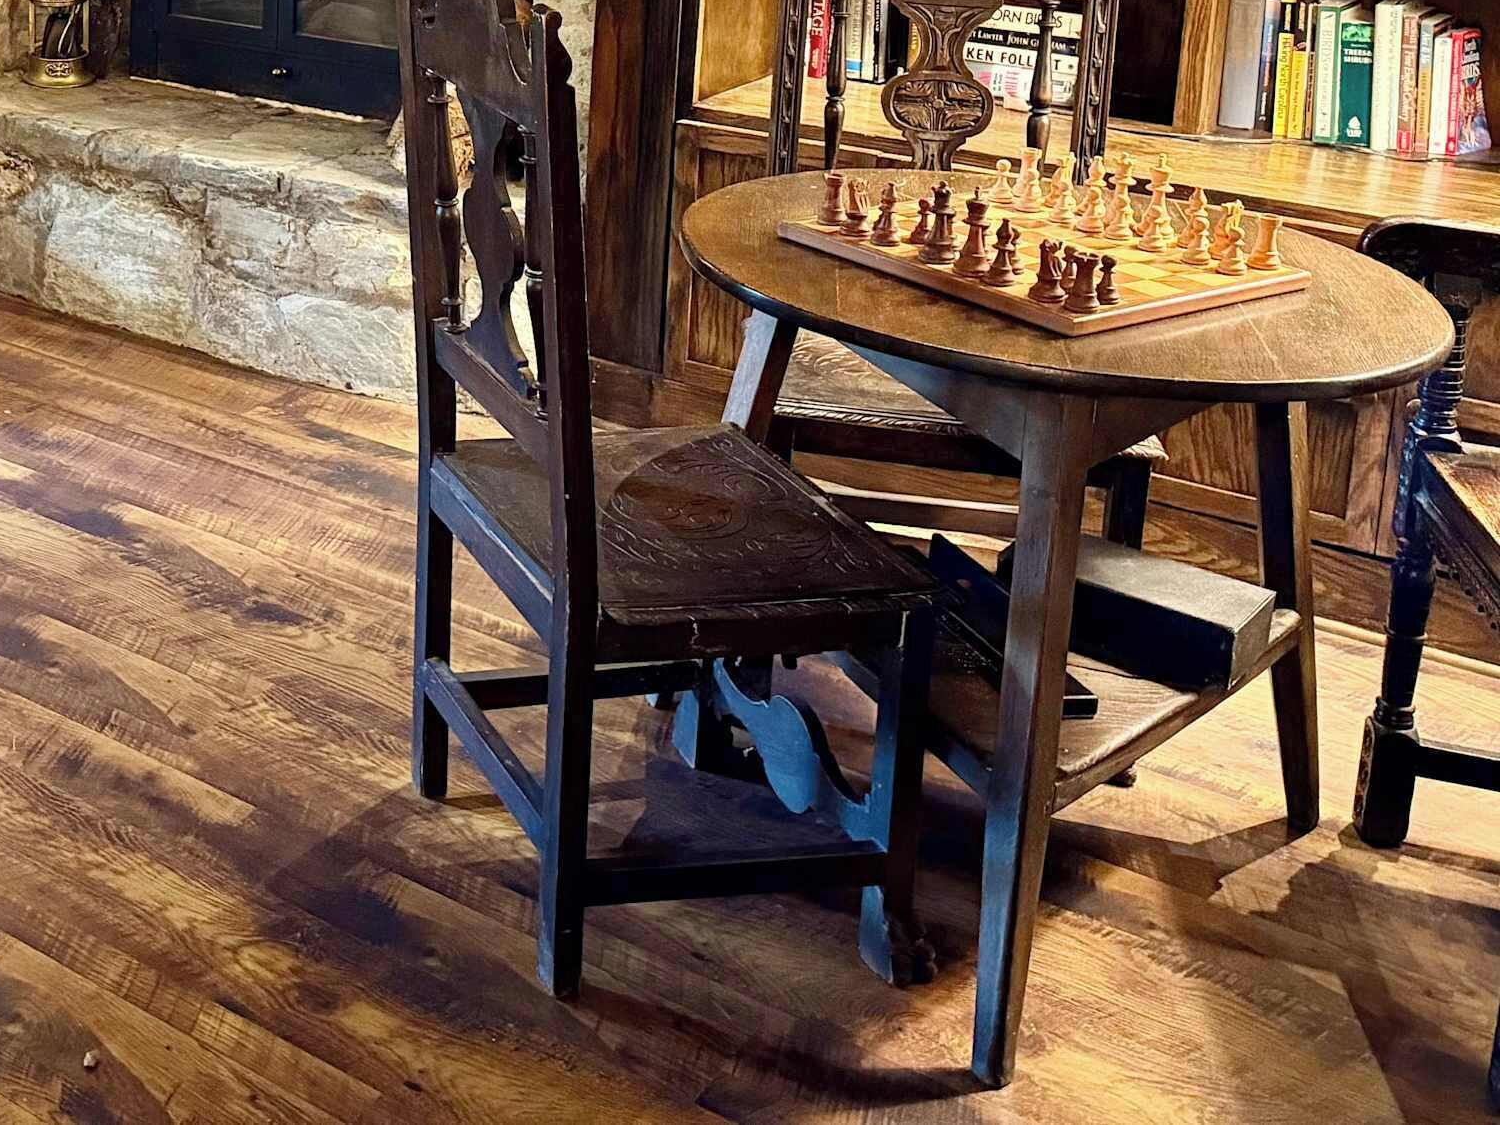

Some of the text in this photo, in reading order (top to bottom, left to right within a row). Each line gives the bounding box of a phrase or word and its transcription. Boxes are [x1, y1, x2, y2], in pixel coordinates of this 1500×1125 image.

[991, 8, 1063, 28] ORN BIS
[966, 47, 1062, 71] KEN FOLLT
[1278, 37, 1291, 63] Hiking
[1320, 30, 1333, 63] BIRDS
[1278, 63, 1289, 87] North
[1398, 50, 1414, 122] Fine English Cookery
[1276, 88, 1288, 119] Carolina
